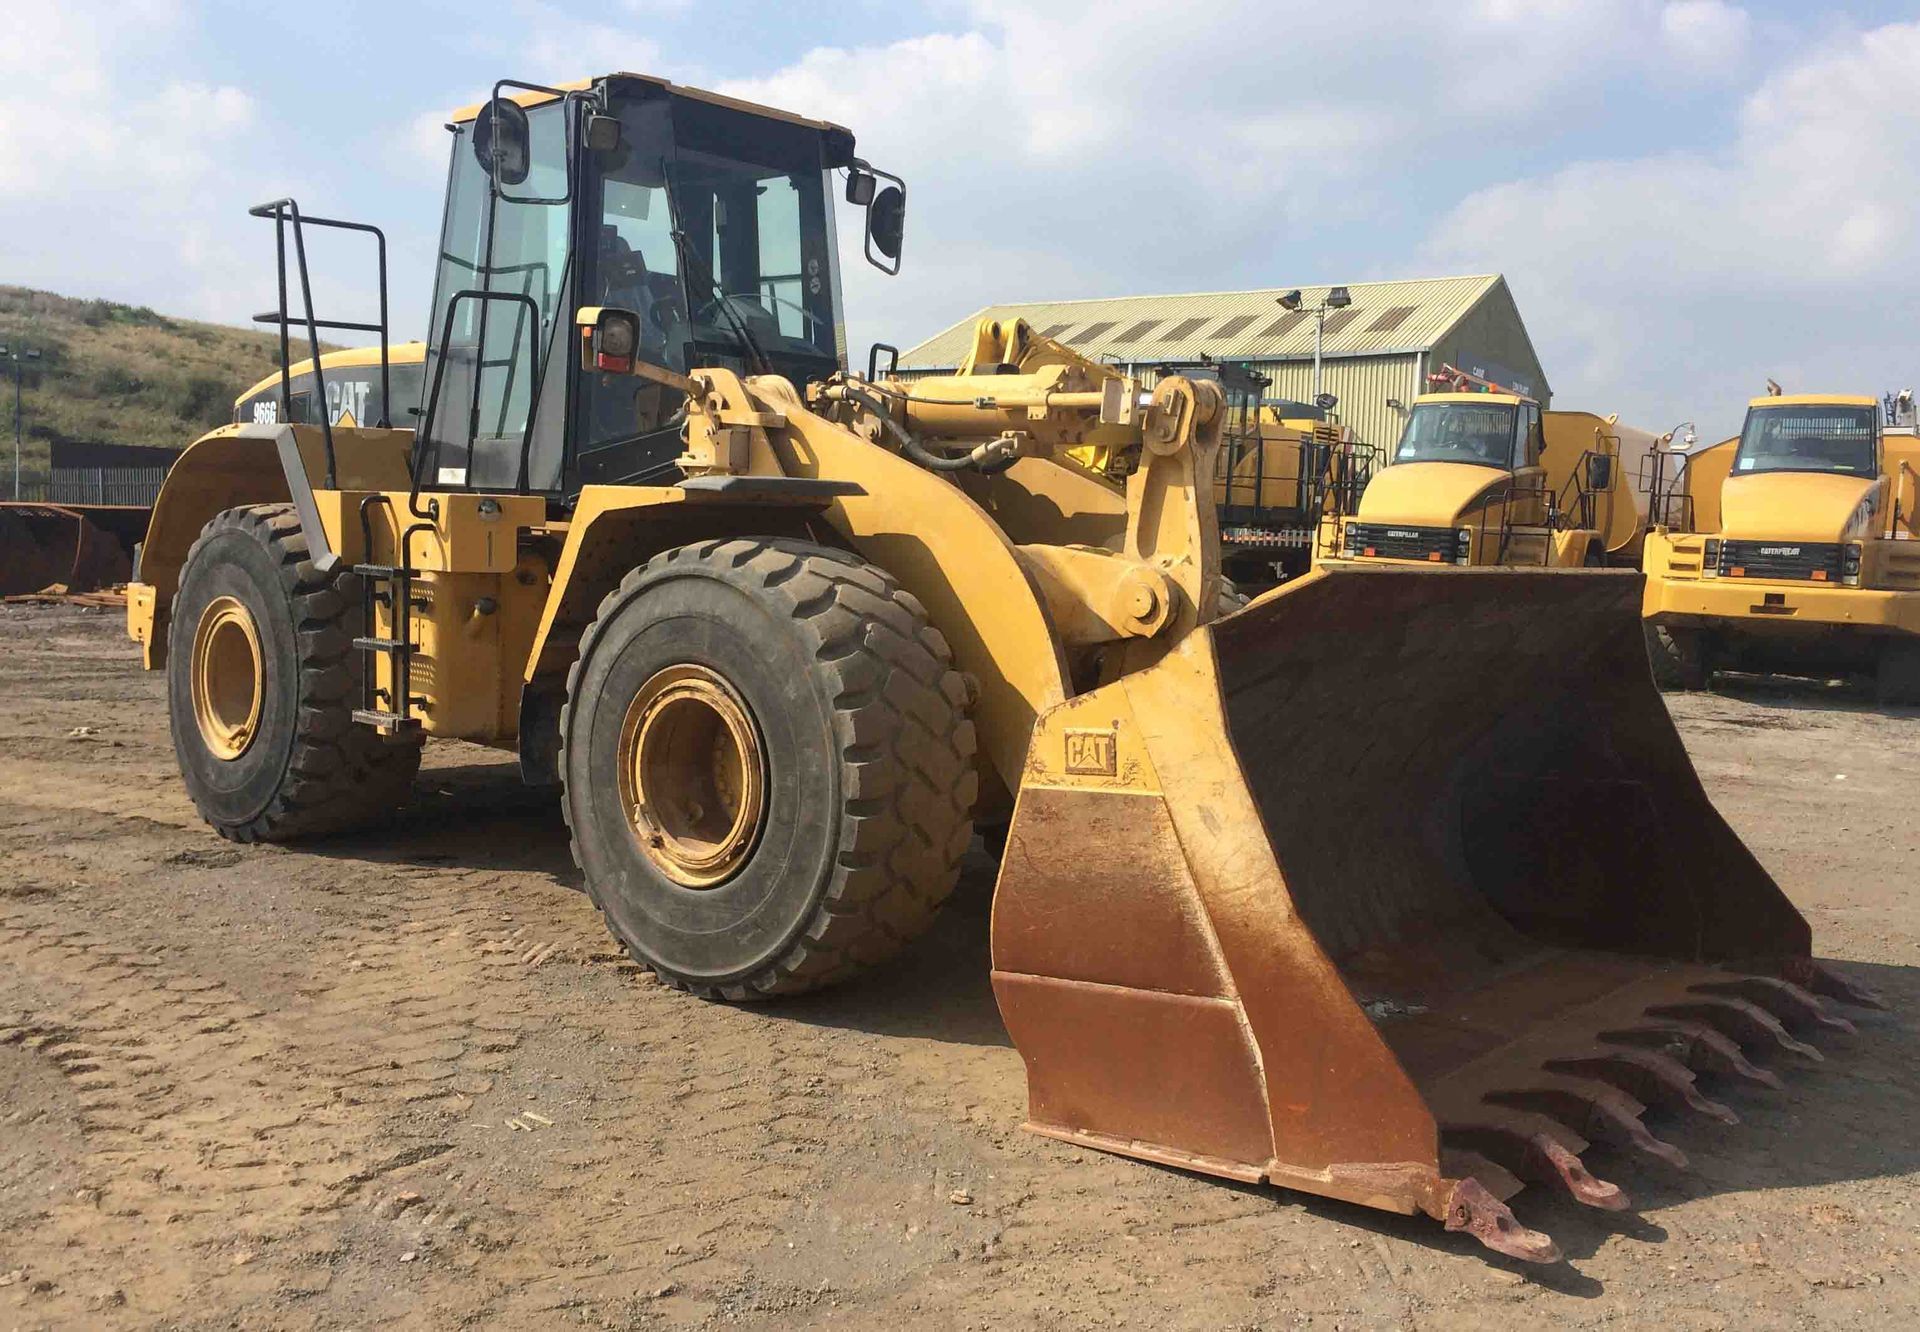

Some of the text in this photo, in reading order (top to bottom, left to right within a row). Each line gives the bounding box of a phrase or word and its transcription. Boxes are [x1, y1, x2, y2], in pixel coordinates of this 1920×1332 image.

[253, 401, 277, 424] 966G
[326, 381, 370, 427] CAT
[1067, 735, 1110, 771] CAT
